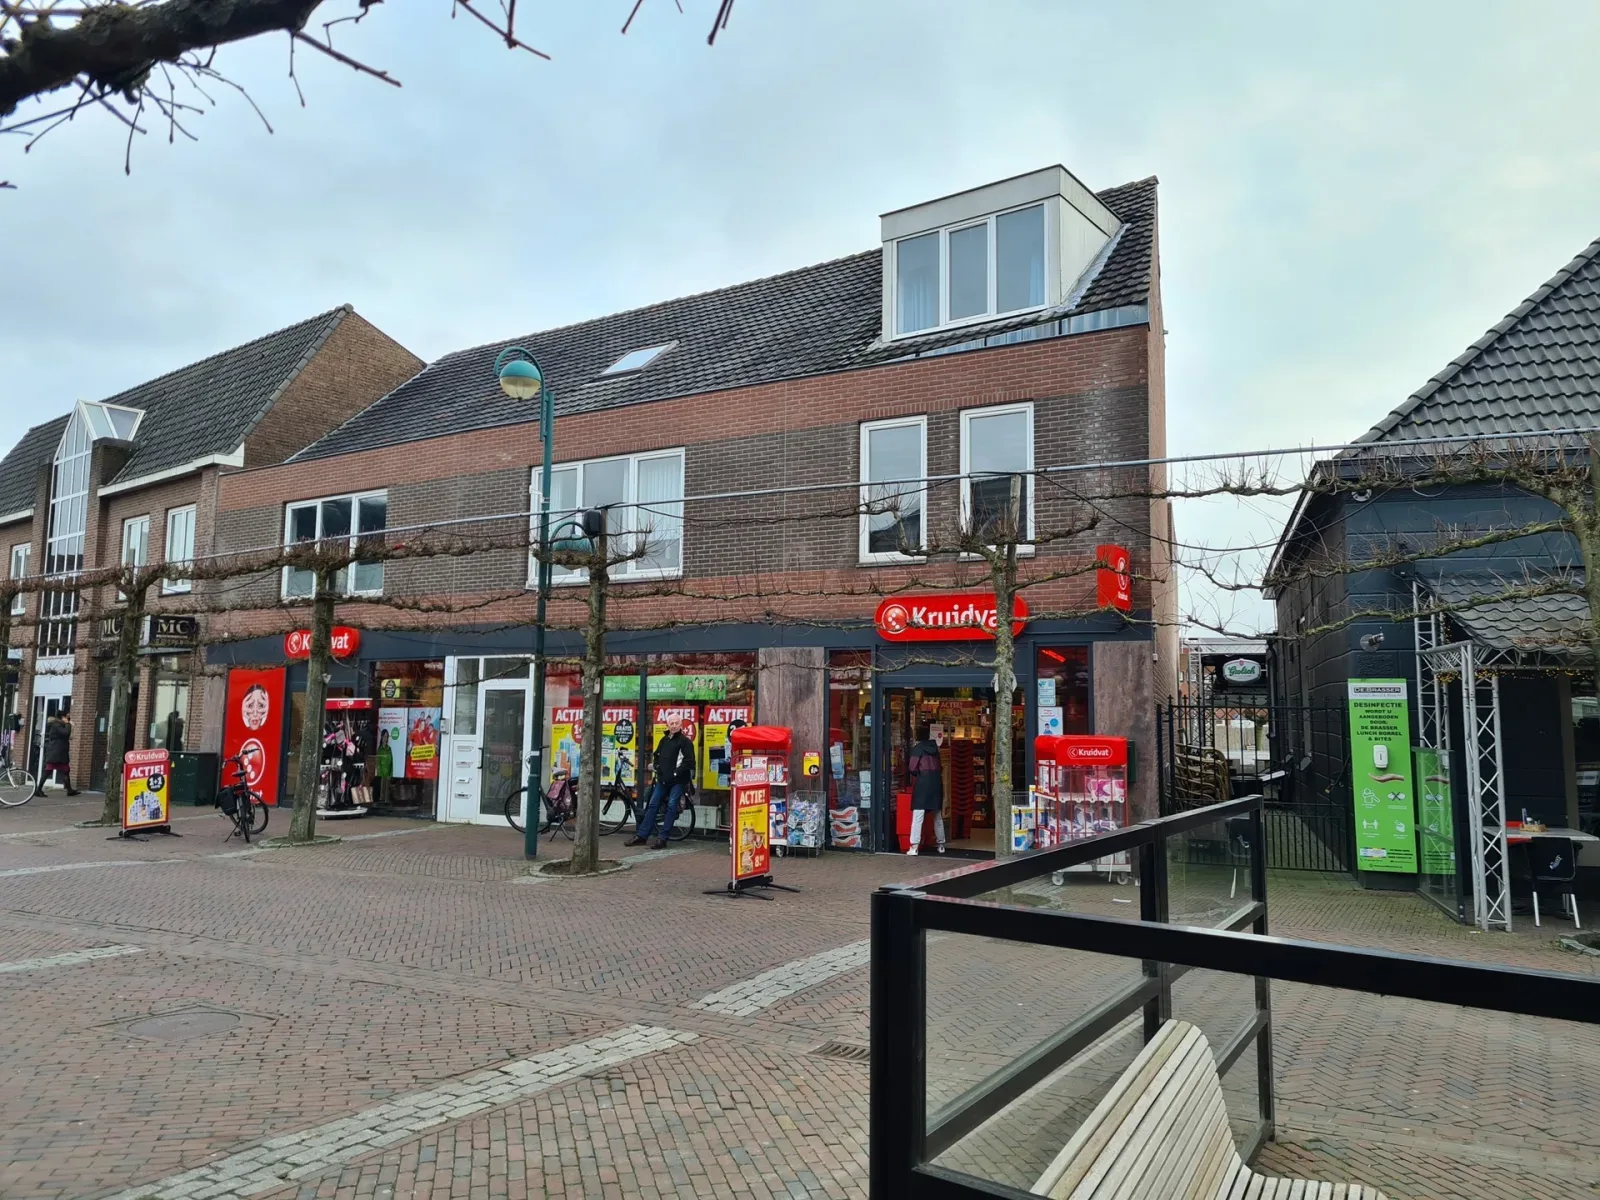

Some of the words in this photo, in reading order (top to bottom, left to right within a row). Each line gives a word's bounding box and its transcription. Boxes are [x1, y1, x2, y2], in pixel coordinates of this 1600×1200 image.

[912, 603, 997, 628] Kruidva
[157, 619, 189, 634] MC
[302, 633, 349, 650] Kvat
[556, 709, 584, 721] ACTI
[657, 708, 695, 721] ACTIE!
[708, 708, 748, 722] ACTIE!
[136, 752, 166, 761] Kruidvat
[1078, 748, 1109, 756] Kruidvat
[130, 764, 164, 778] ACTIE!
[743, 771, 766, 782] Kruidvat
[149, 776, 163, 786] 1+1
[739, 789, 766, 805] ACTIE!
